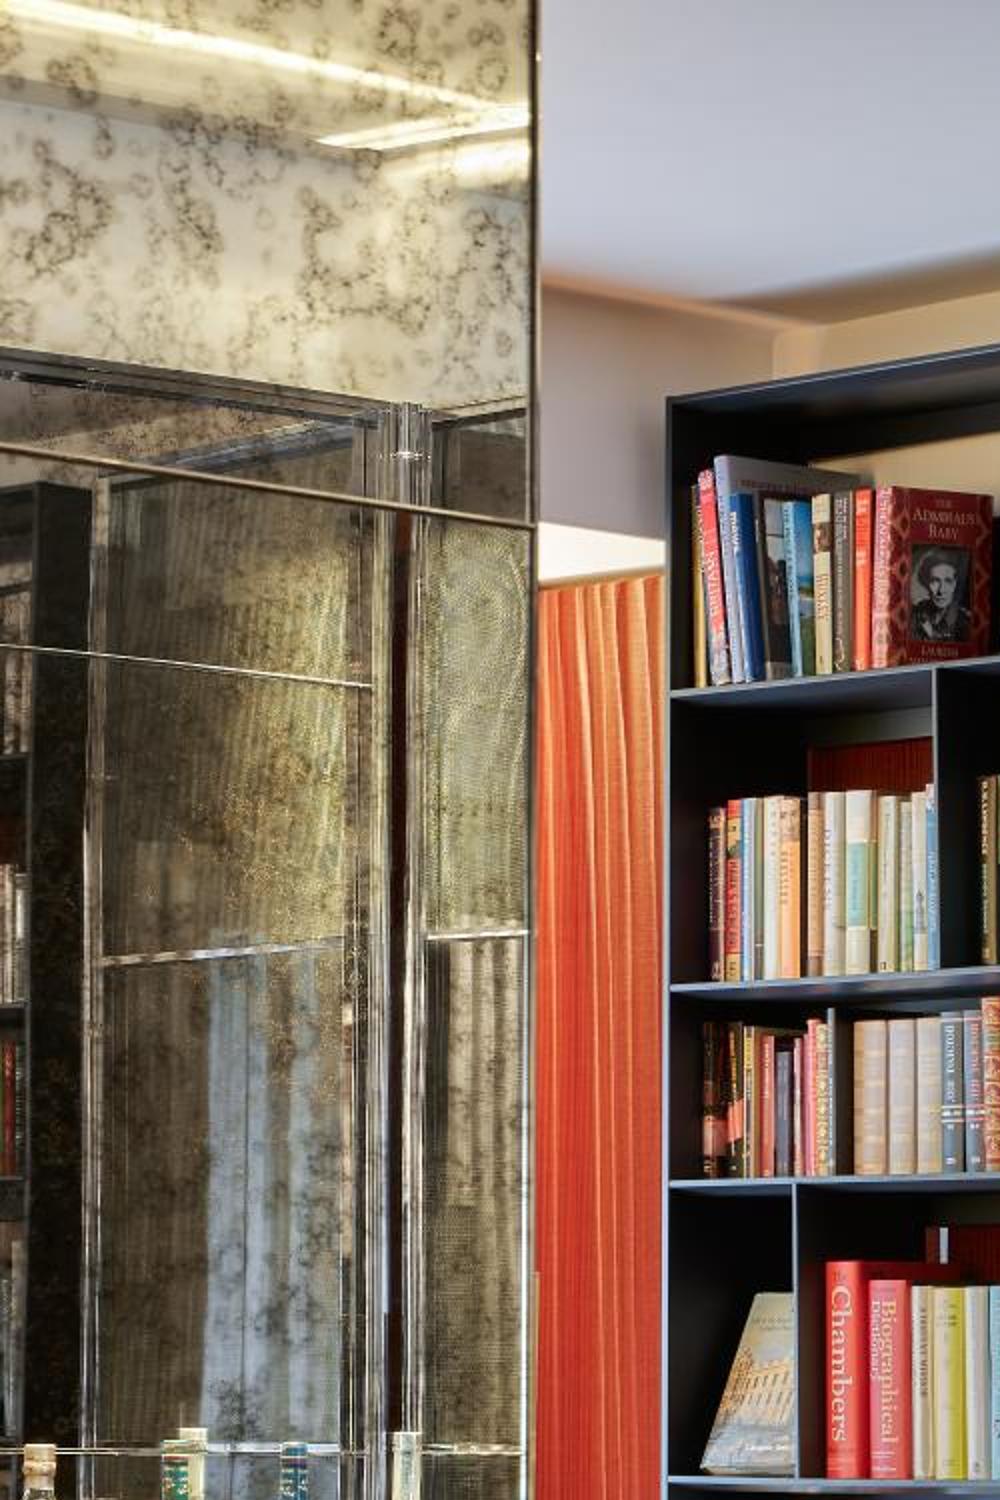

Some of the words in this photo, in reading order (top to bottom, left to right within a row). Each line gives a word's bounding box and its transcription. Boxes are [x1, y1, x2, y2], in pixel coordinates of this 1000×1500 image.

[928, 525, 959, 540] BABY
[831, 1285, 853, 1442] Chambers
[869, 1300, 881, 1380] Dictionary
[879, 1300, 899, 1444] Biographical
